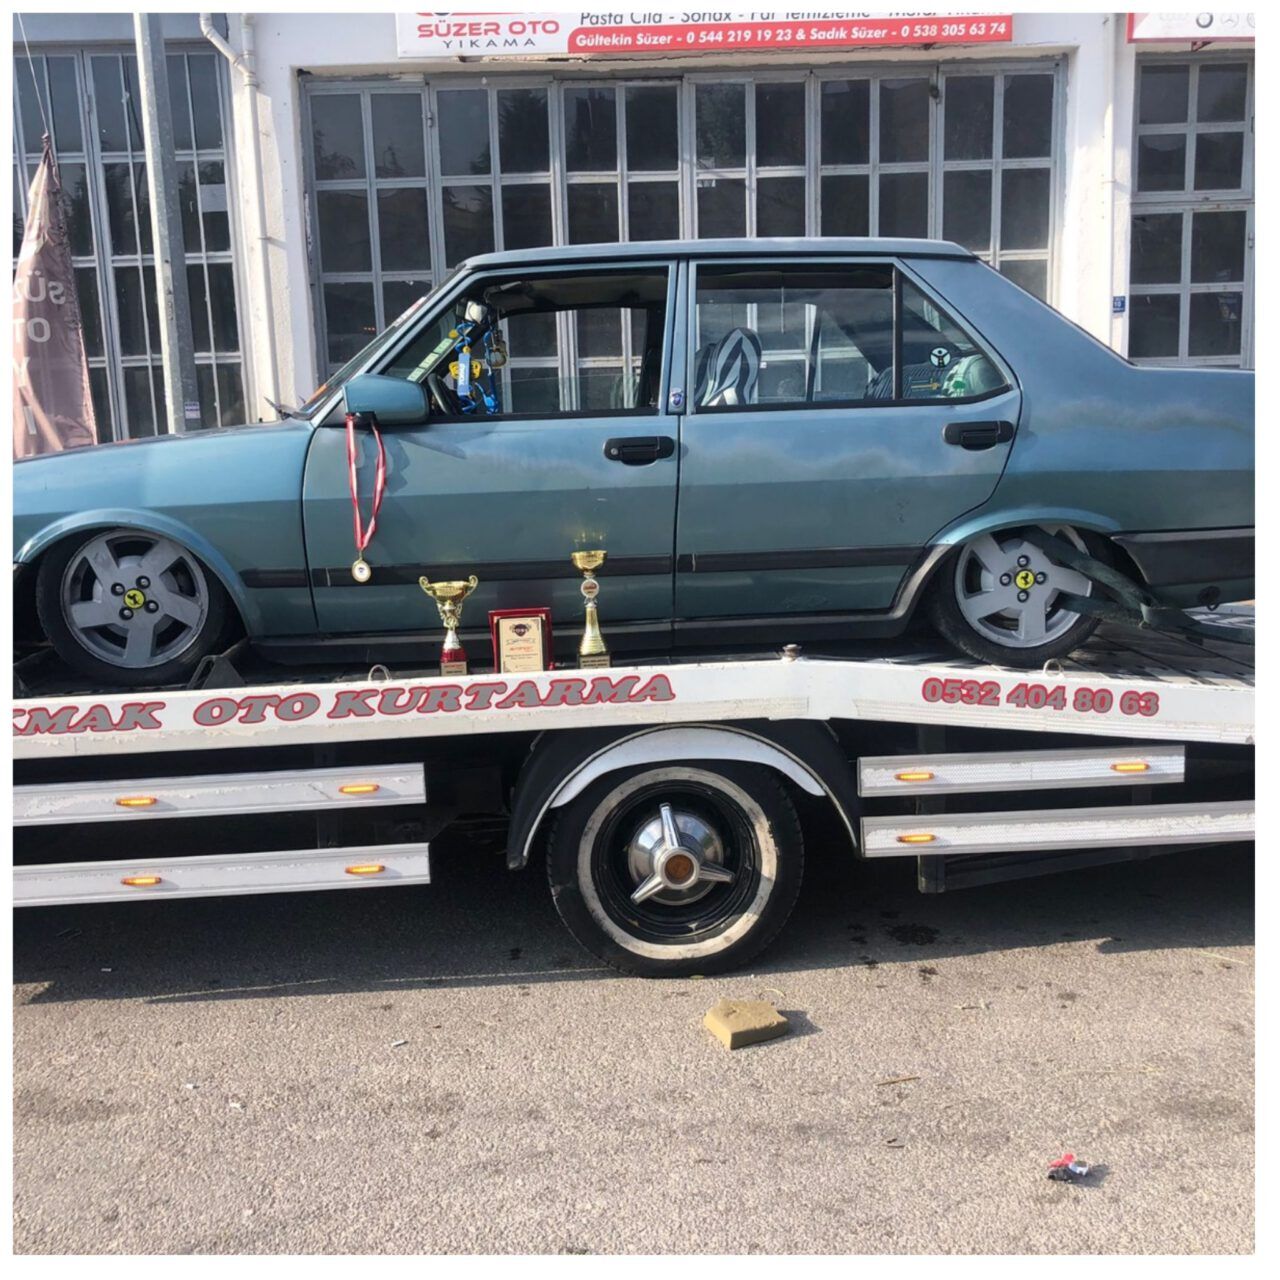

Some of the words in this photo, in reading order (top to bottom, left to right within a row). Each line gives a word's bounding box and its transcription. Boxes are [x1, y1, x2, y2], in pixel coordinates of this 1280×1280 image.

[418, 20, 500, 38] SÜZER
[509, 20, 560, 34] OTO
[576, 34, 632, 47] Gültekin
[636, 33, 672, 45] Süzer
[686, 32, 695, 44] 0
[698, 31, 723, 43] 544
[727, 30, 752, 42] 219
[756, 29, 771, 41] 19
[776, 29, 791, 41] 23
[795, 29, 806, 40] &
[810, 27, 847, 40] Sadık
[851, 26, 888, 39] Süzer
[901, 26, 910, 37] 0
[913, 25, 937, 37] 538
[941, 24, 966, 36] 305
[969, 23, 985, 35] 63
[989, 23, 1006, 34] 74
[443, 38, 536, 49] YIKAMA
[192, 691, 321, 727] OTO
[326, 674, 677, 720] KURTARMA
[922, 677, 1000, 707] 0532
[1006, 683, 1067, 710] 404
[1073, 687, 1113, 713] 80
[1119, 690, 1159, 717] 63
